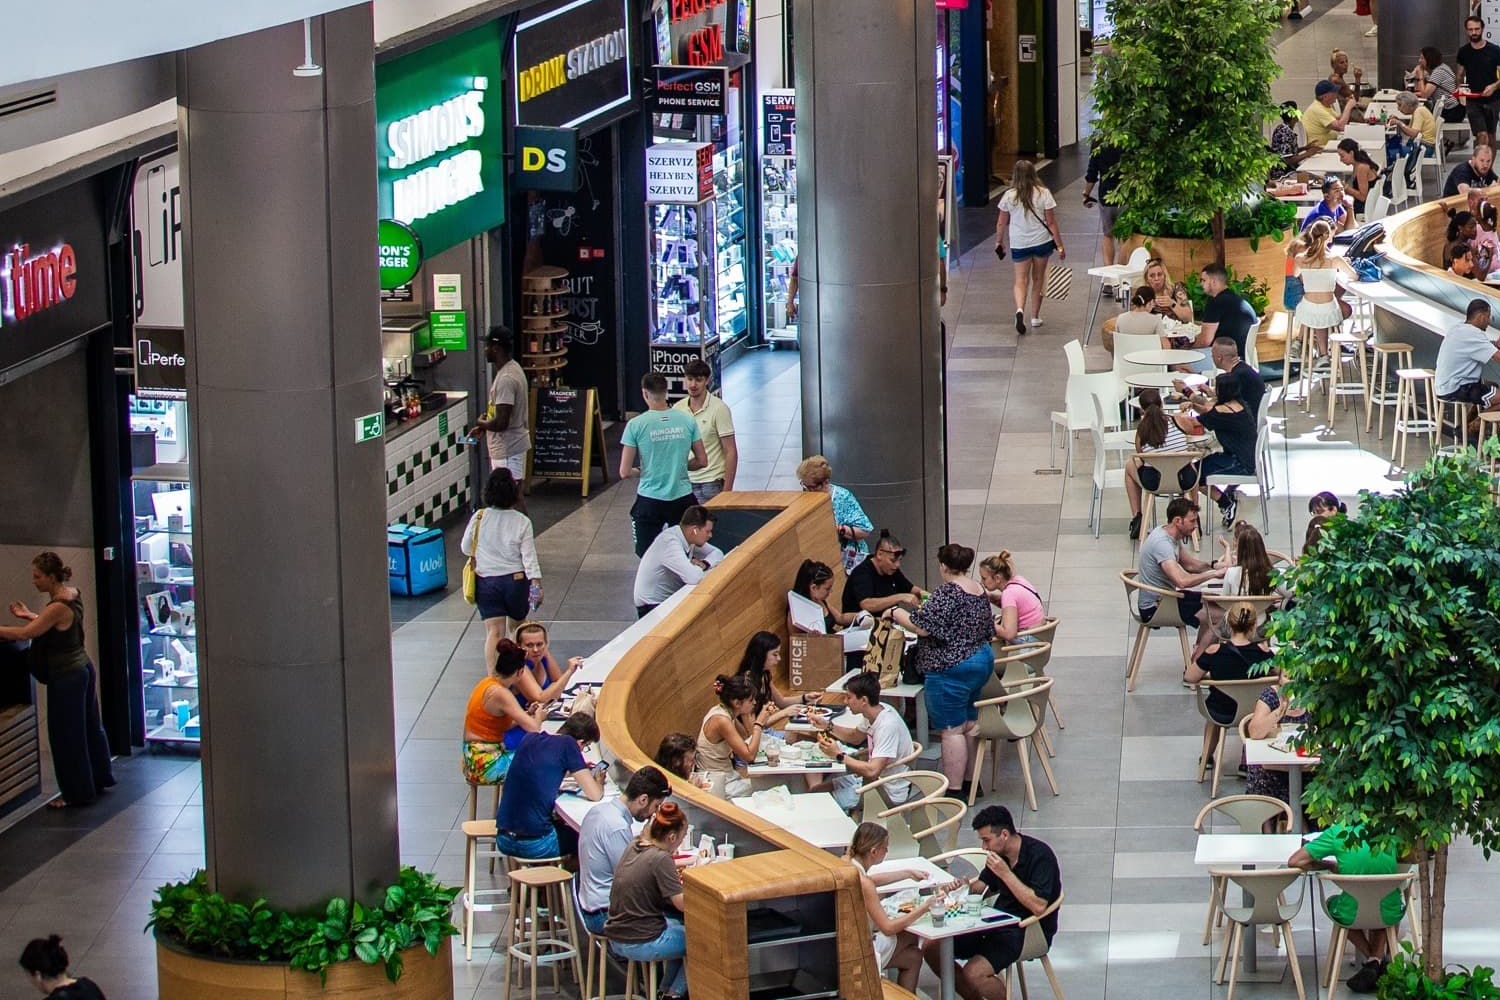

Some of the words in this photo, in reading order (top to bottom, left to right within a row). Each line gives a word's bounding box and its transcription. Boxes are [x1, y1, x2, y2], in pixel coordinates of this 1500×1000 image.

[687, 24, 723, 67] GSM
[520, 54, 567, 102] DRINK
[567, 28, 626, 80] STATION
[695, 81, 721, 93] GSM
[658, 97, 686, 106] PHONE
[687, 98, 721, 107] SERVICE
[522, 147, 567, 173] DS
[648, 157, 694, 167] SZERVIZ
[649, 171, 694, 181] HELYBEN
[649, 185, 695, 195] SZERVIZ
[11, 243, 77, 320] time
[652, 349, 699, 363] iPhone
[792, 639, 803, 687] OFFICE
